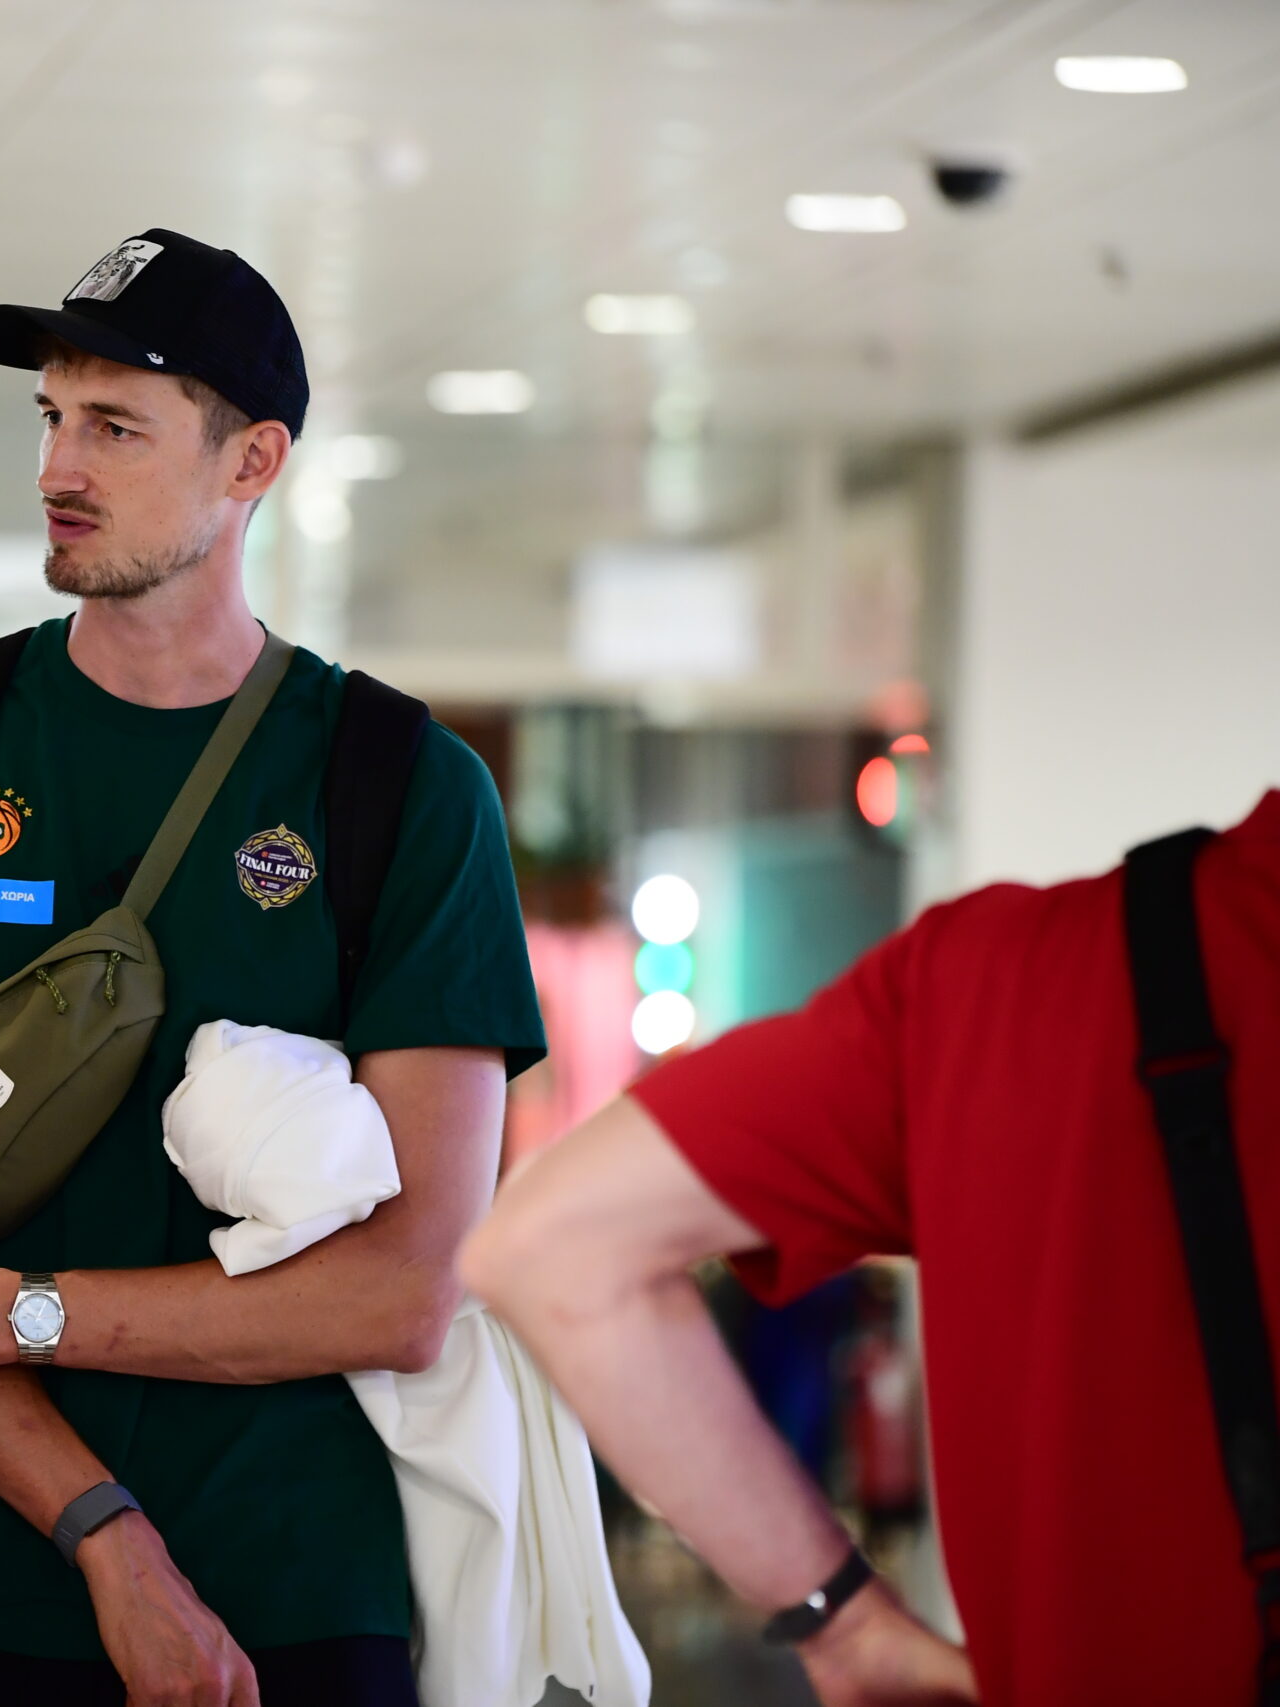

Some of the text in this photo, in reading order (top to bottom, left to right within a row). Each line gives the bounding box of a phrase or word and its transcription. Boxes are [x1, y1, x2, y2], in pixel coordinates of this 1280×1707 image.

[240, 853, 273, 874] FINAL
[275, 864, 310, 880] FOUR
[1, 891, 35, 902] ΧΩΡΙΑ
